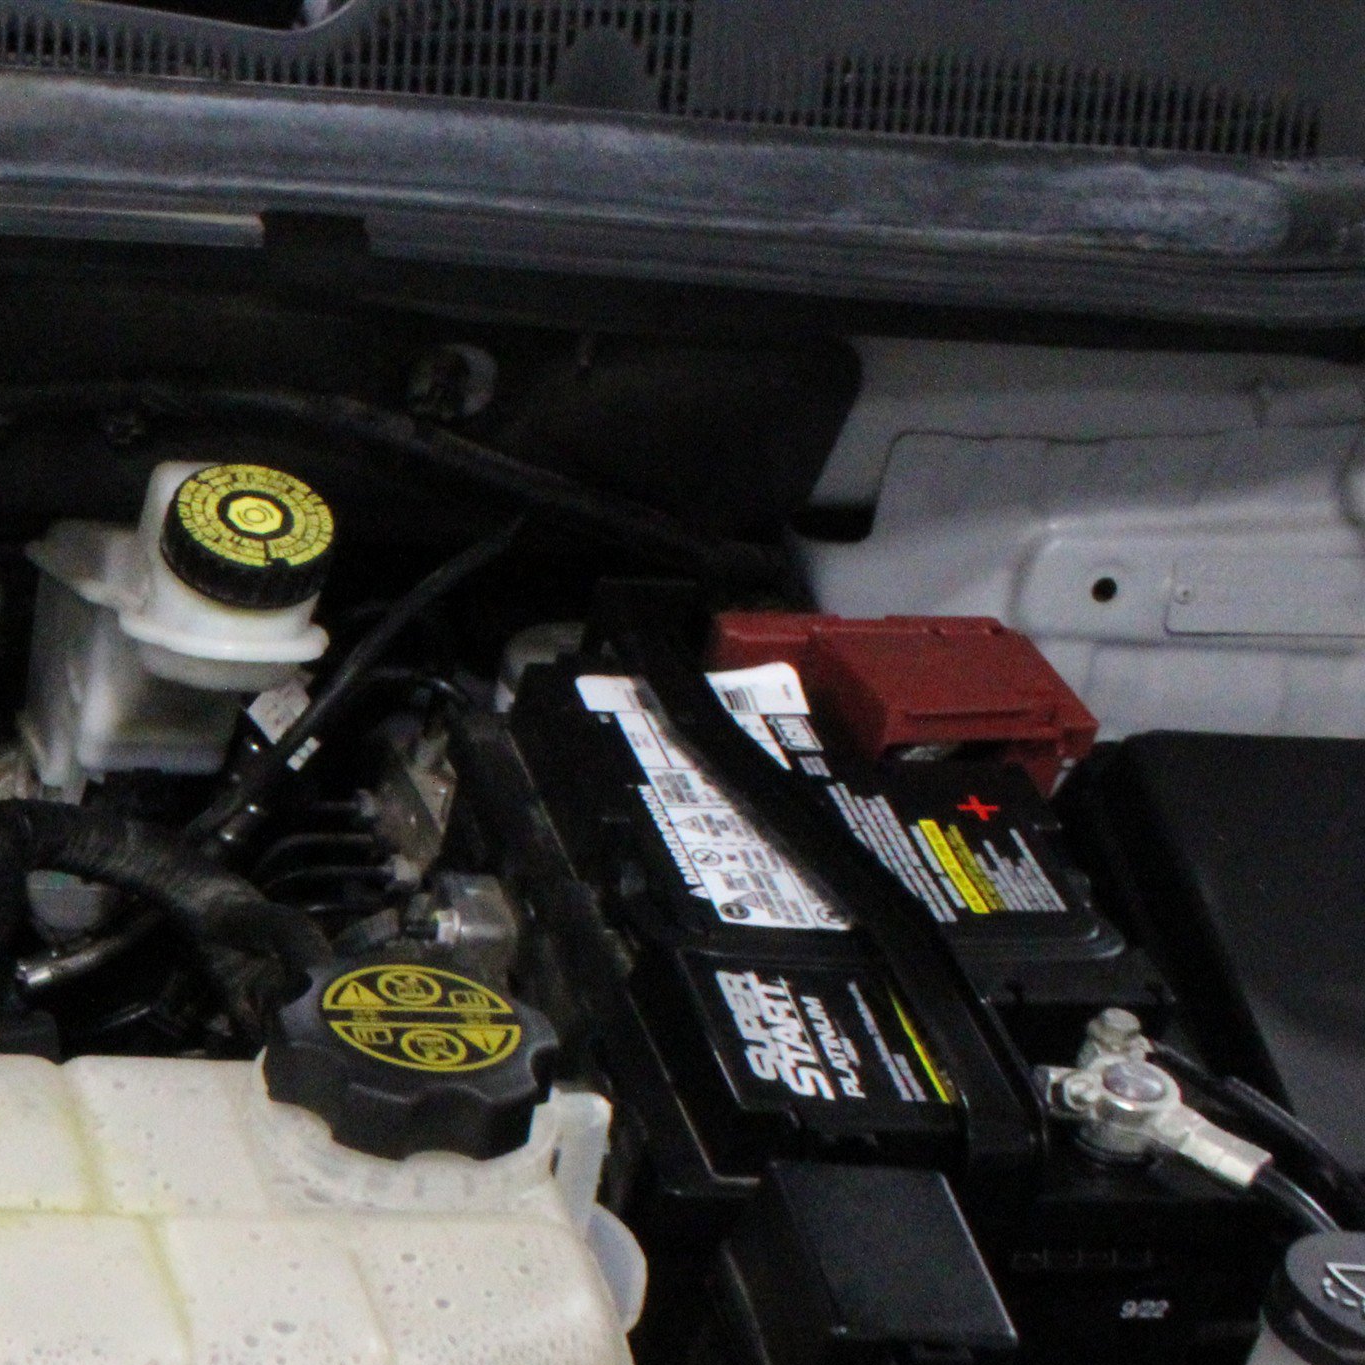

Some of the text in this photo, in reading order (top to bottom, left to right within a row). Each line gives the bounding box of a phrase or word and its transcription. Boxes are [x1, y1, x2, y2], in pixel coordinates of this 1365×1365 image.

[715, 970, 779, 1081] SUPER
[743, 970, 836, 1101] START
[800, 995, 867, 1099] PLATINUM
